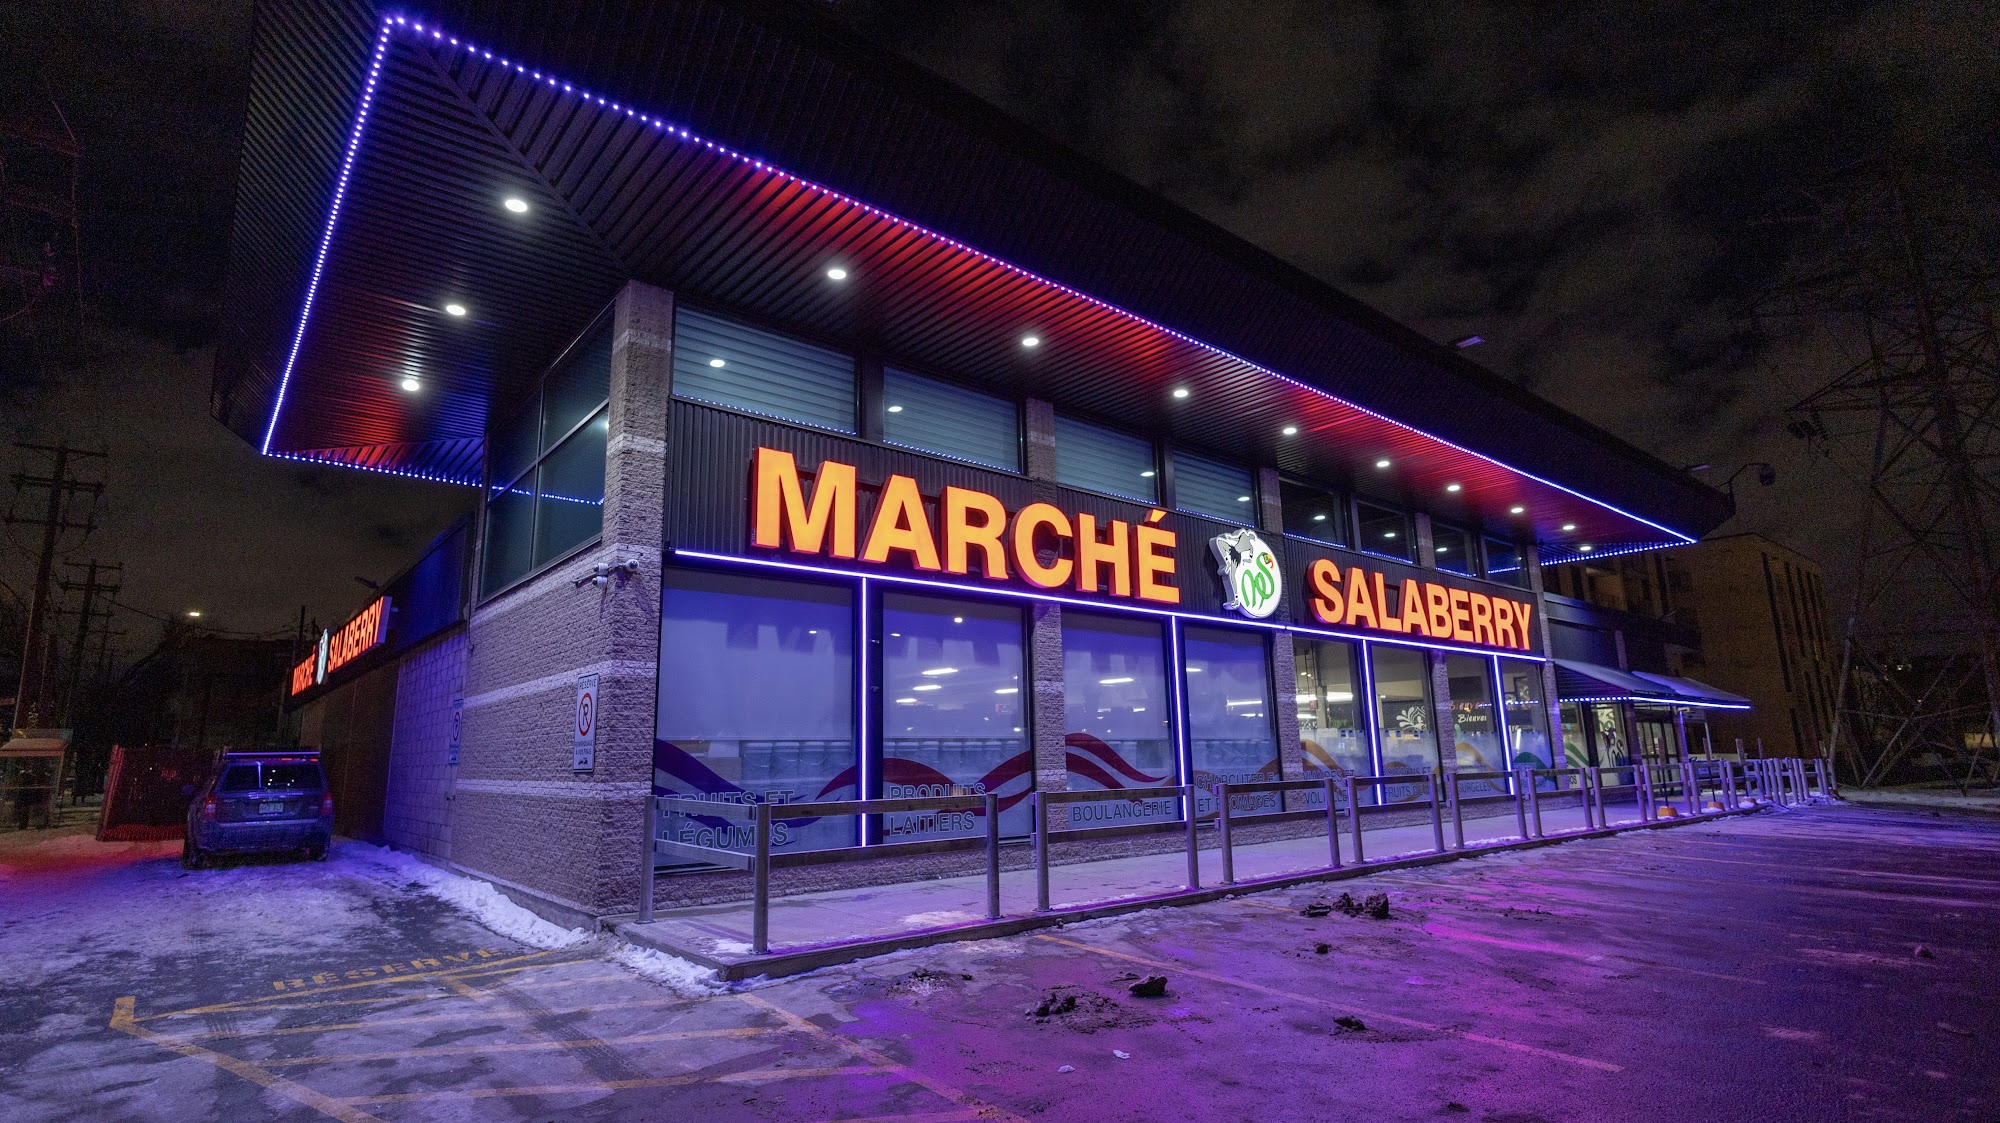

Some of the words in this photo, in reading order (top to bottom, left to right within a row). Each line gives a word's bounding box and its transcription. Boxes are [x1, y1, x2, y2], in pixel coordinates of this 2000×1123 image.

[752, 446, 1180, 603] MARCHÉ
[1308, 558, 1531, 650] SALABERRY
[328, 596, 384, 673] SALABERRY
[1457, 713, 1487, 723] Bienve
[1072, 800, 1172, 822] BOULANGERIE
[1198, 798, 1212, 813] ET
[1215, 793, 1276, 811] FOMAGES
[662, 822, 788, 849] ÉGUMS
[889, 811, 975, 836] LAITIERS
